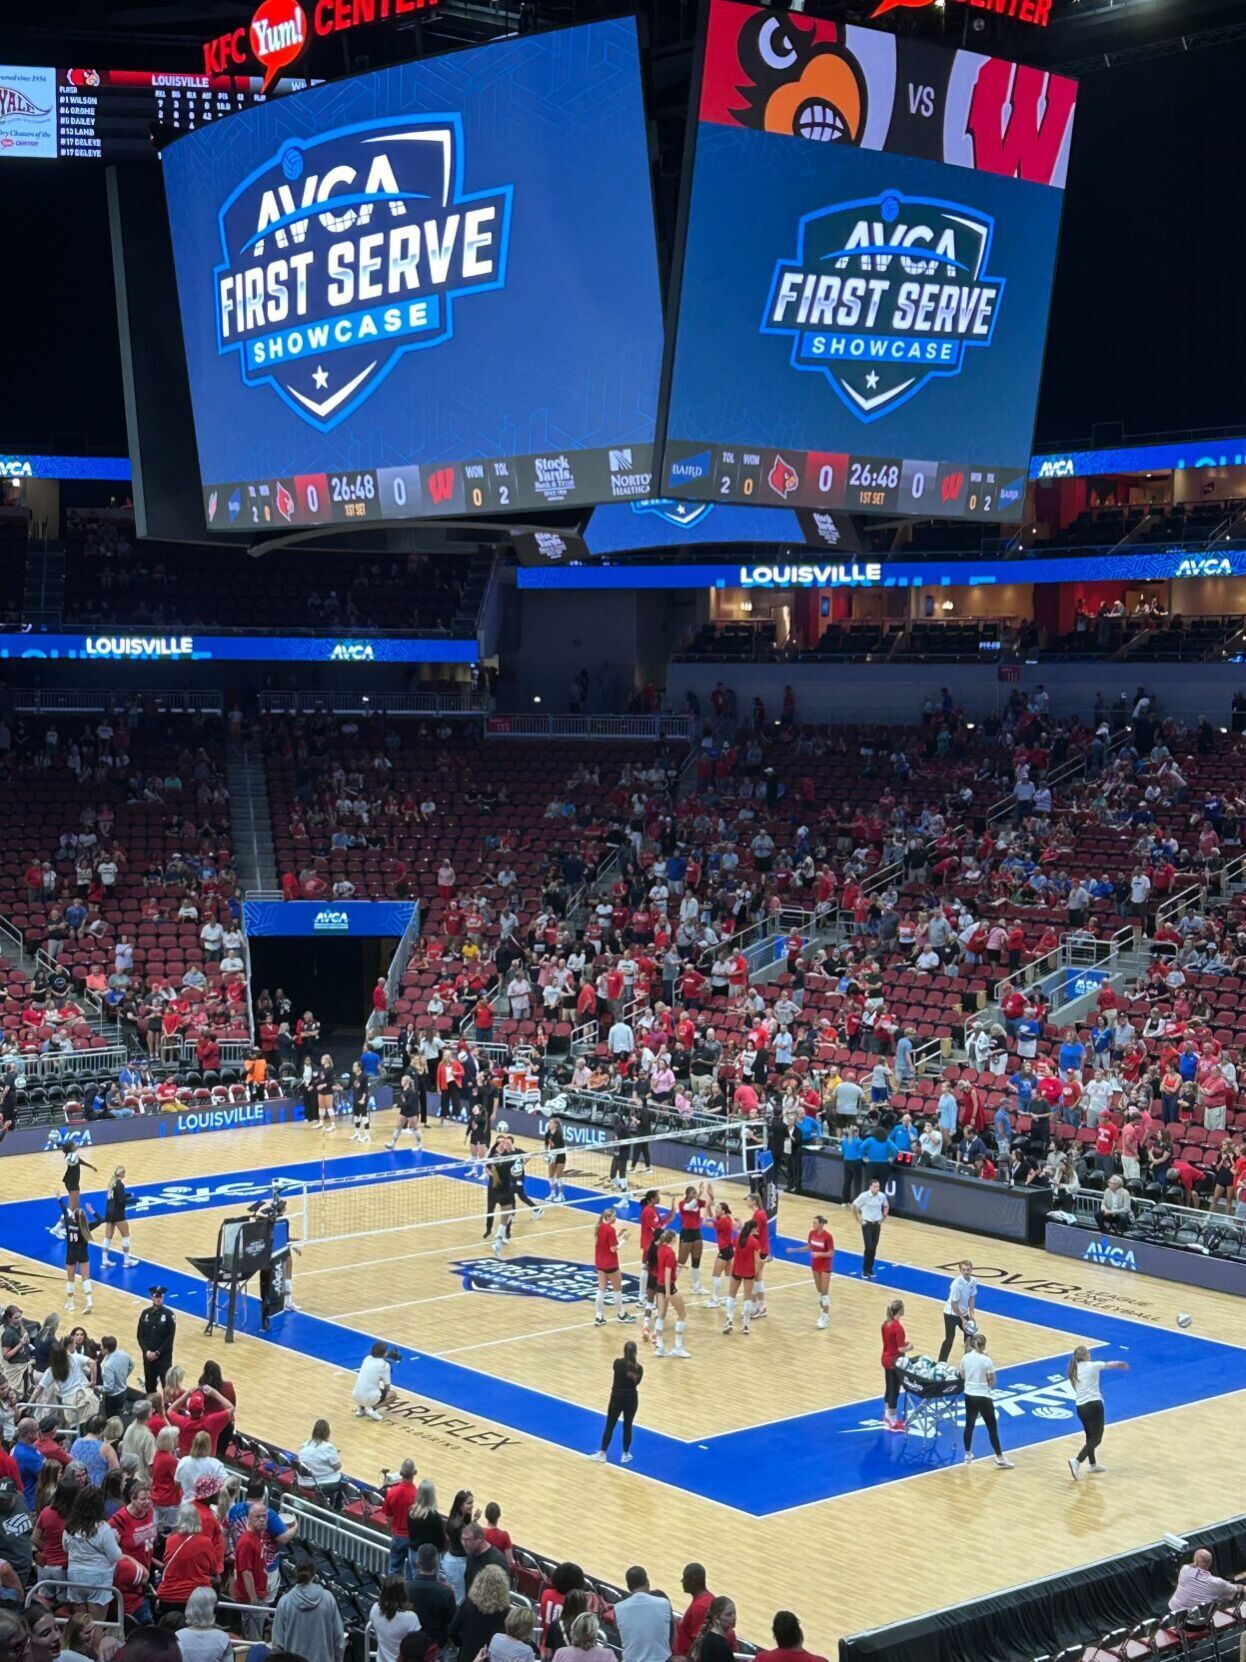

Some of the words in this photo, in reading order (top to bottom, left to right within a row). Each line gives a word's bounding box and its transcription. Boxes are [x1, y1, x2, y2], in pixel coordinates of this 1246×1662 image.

[203, 27, 246, 77] KFC
[252, 6, 303, 57] Yum!
[314, 0, 438, 35] CEN
[151, 74, 210, 88] LOUISVILLE
[907, 83, 935, 117] VS
[253, 154, 407, 257] AVCA
[834, 220, 958, 279] AVCA
[220, 252, 314, 338] FIRST
[326, 206, 496, 307] SERVE
[772, 272, 891, 328] FIRST
[892, 281, 997, 335] SERVE
[253, 302, 428, 364] SHOWCASE
[811, 336, 953, 361] SHOWCASE
[610, 473, 652, 488] NORTO
[1039, 459, 1075, 478] AVCA
[306, 484, 319, 513] 0
[331, 473, 376, 502] 26:48
[393, 477, 407, 506] 0
[472, 487, 483, 507] 0
[498, 485, 510, 505] 2
[719, 476, 731, 494] 2
[743, 477, 754, 496] 0
[818, 464, 834, 493] 0
[849, 462, 899, 489] 26:48
[911, 472, 925, 500] 0
[969, 494, 977, 511] 0
[983, 495, 992, 512] 2
[740, 562, 882, 585] LOUISVILLE
[1175, 559, 1234, 579] AVCA
[86, 636, 194, 657] LOUISVILLE
[329, 644, 375, 662] AVCA
[314, 911, 350, 924] AVCA
[178, 1105, 264, 1131] LOUISVILLE
[538, 1119, 607, 1146] LISVILLE
[687, 1153, 728, 1178] AVCA
[460, 1259, 555, 1281] FIRST
[1083, 1242, 1137, 1271] AVCA
[468, 1270, 577, 1301] SHOWCASE
[934, 1259, 1082, 1295] LOVB
[1063, 1295, 1162, 1322] VOLLEYBALL
[378, 1400, 523, 1451] ARAFLEX
